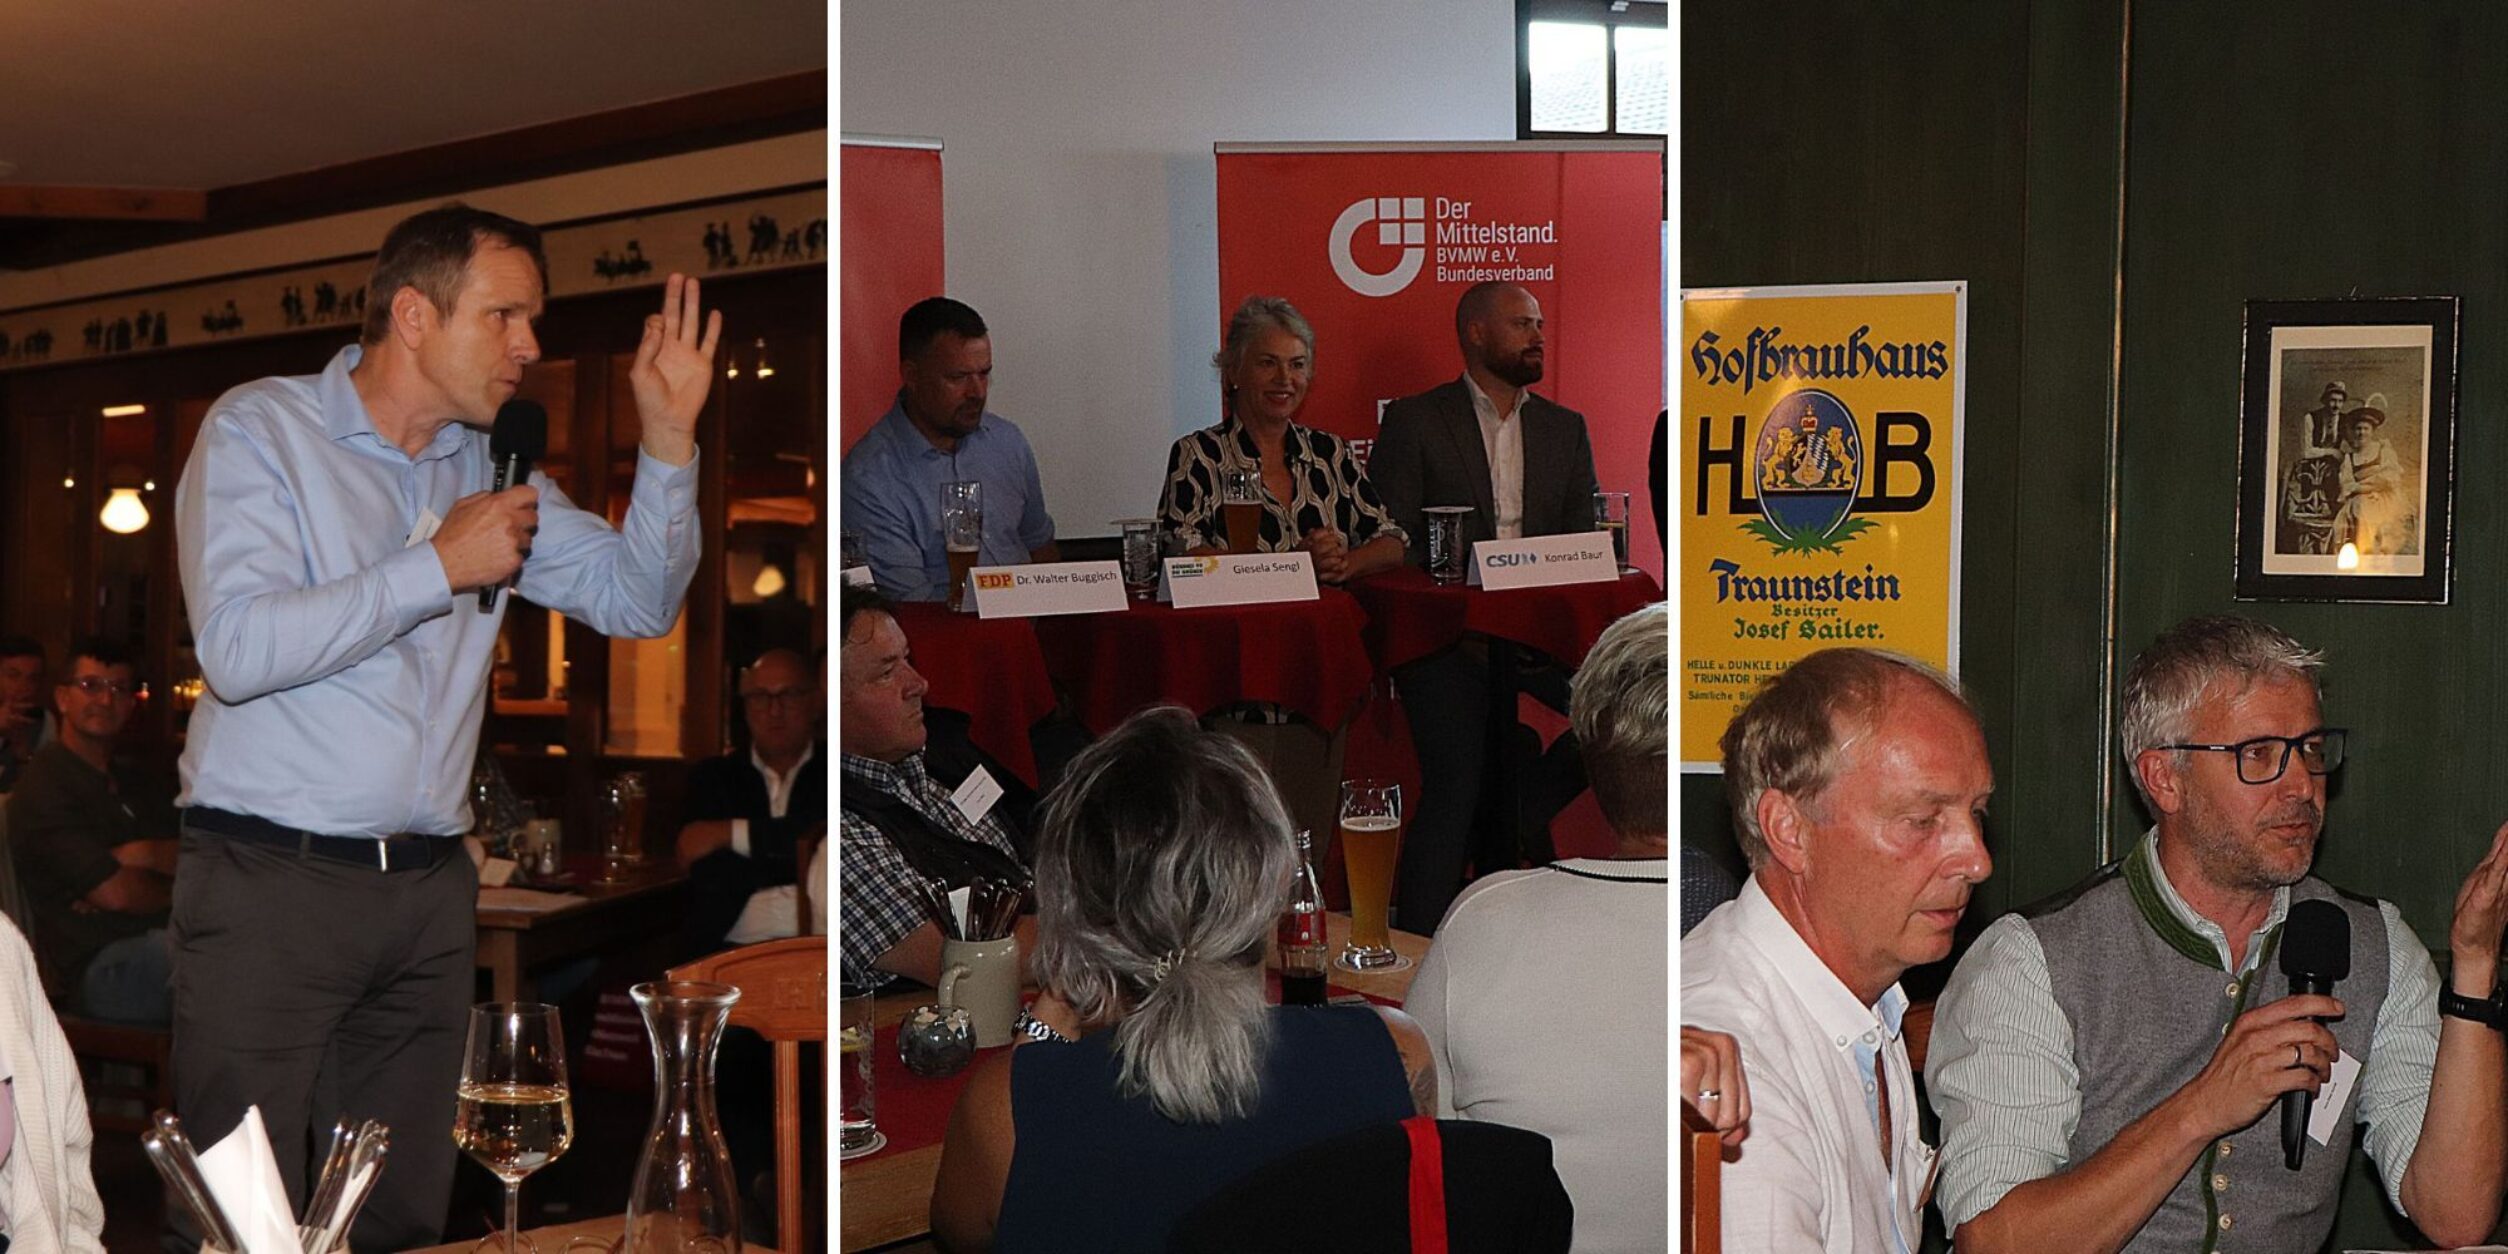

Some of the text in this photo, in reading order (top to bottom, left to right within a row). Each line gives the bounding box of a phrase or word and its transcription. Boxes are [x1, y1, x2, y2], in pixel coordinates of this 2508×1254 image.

[1436, 198, 1471, 219] Der
[1436, 221, 1558, 244] Mittelstand.
[1437, 247, 1519, 263] BVMW e.V.
[1437, 265, 1554, 282] Bundesverband
[1486, 551, 1603, 567] CSU Konrad Baur
[1233, 561, 1300, 574] Giesela Sengl
[978, 571, 1117, 588] FDP Dr. Walter Buggisch
[1708, 558, 1901, 603] Traunstein
[1771, 604, 1838, 619] Besitzer
[1733, 618, 1790, 640] Josef
[1687, 660, 1715, 670] HELLE
[1728, 660, 1772, 670] DUNKLE
[1693, 673, 1750, 683] TRUNATOR
